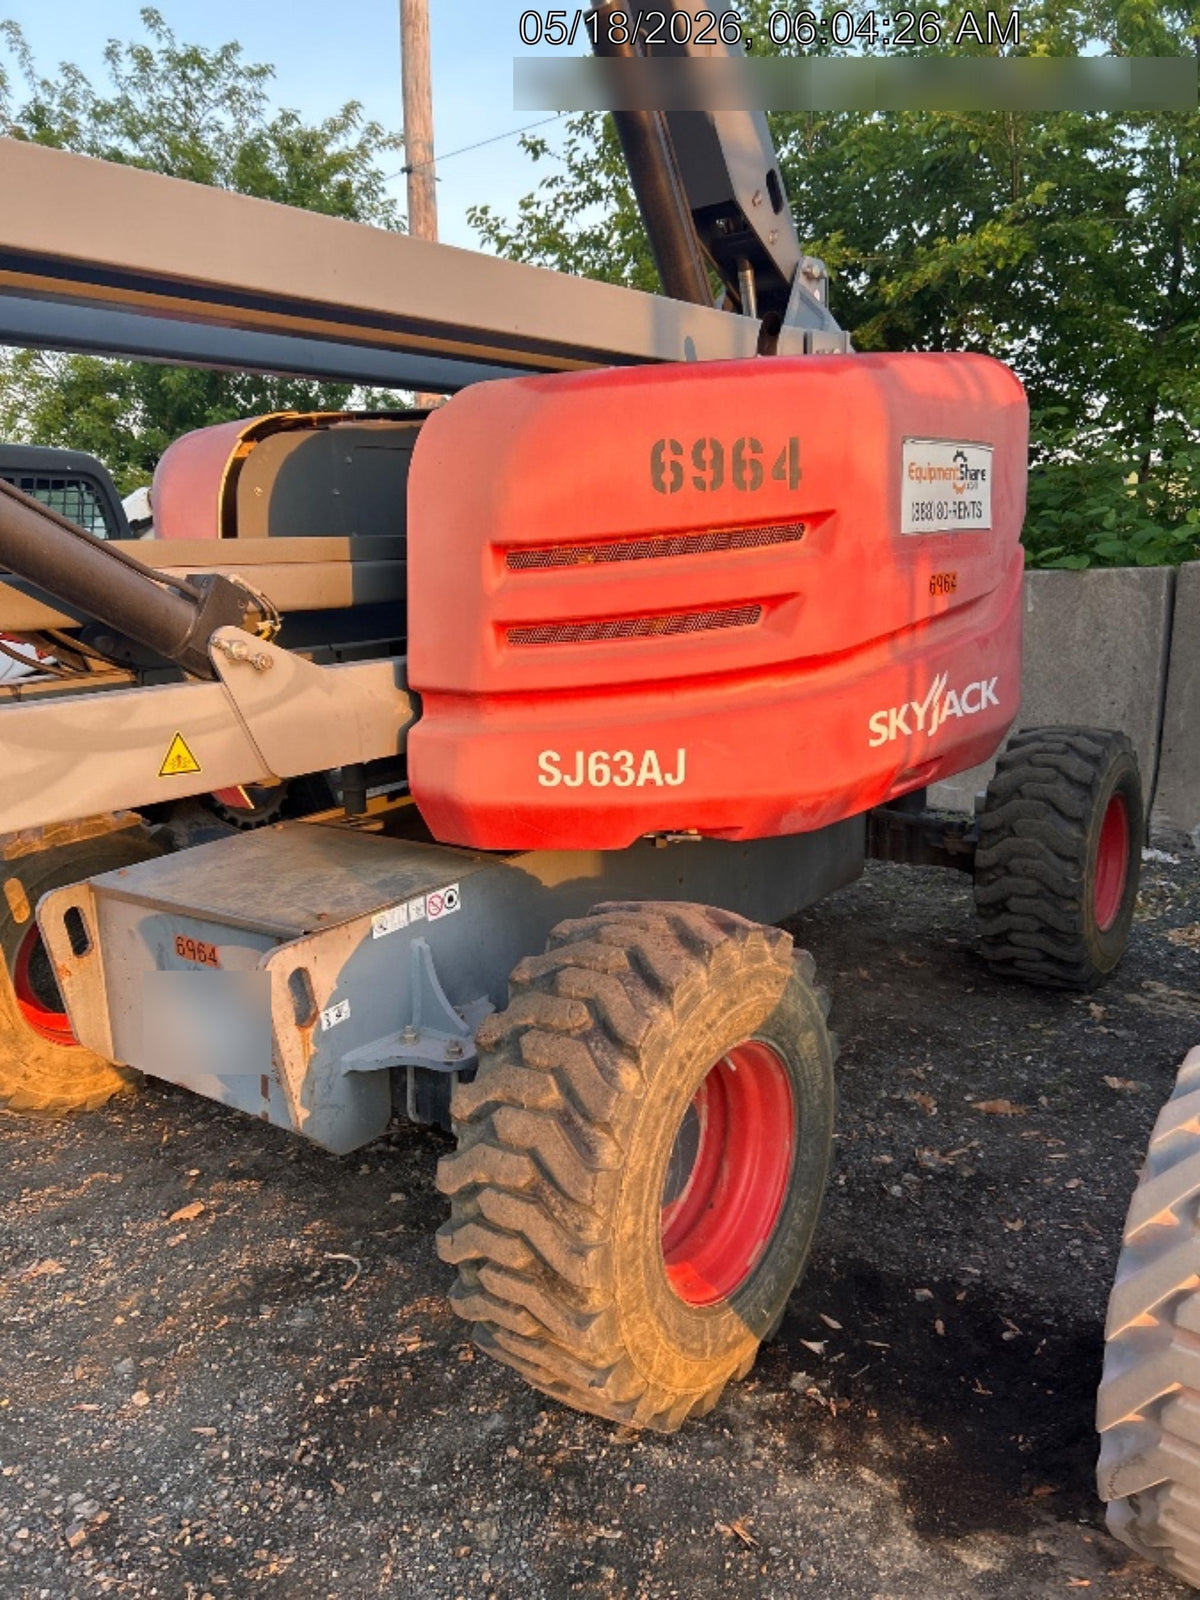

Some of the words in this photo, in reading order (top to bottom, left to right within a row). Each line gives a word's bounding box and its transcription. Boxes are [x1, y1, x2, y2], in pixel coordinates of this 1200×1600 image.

[651, 437, 802, 494] 6964
[908, 462, 986, 484] EquipmentShare
[929, 574, 957, 596] 6964
[869, 671, 999, 747] SKYJACK
[537, 748, 686, 788] SJ63AJ
[175, 936, 218, 965] 6964
